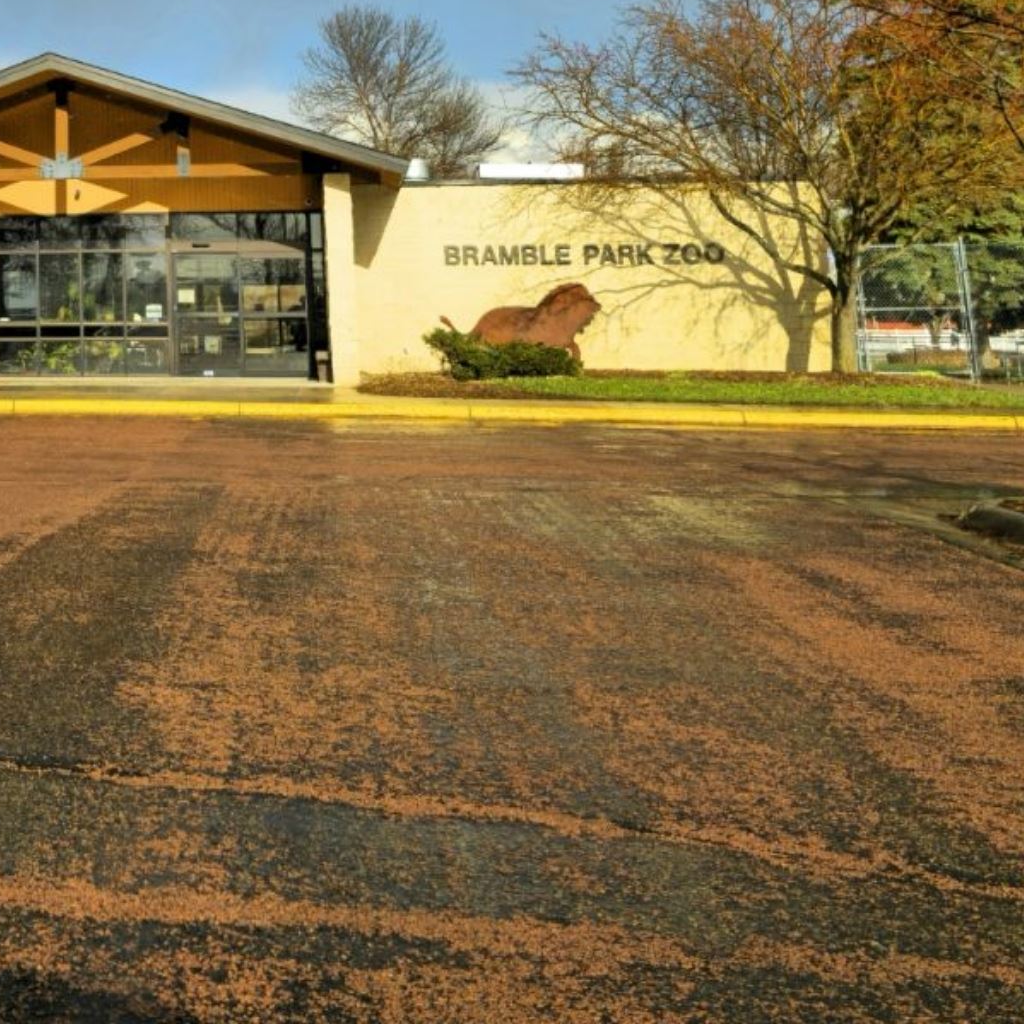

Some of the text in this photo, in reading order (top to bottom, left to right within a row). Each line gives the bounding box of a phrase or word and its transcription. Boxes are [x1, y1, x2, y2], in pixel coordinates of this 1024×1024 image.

[443, 242, 725, 266] BRAMBLE PARK ZOO
